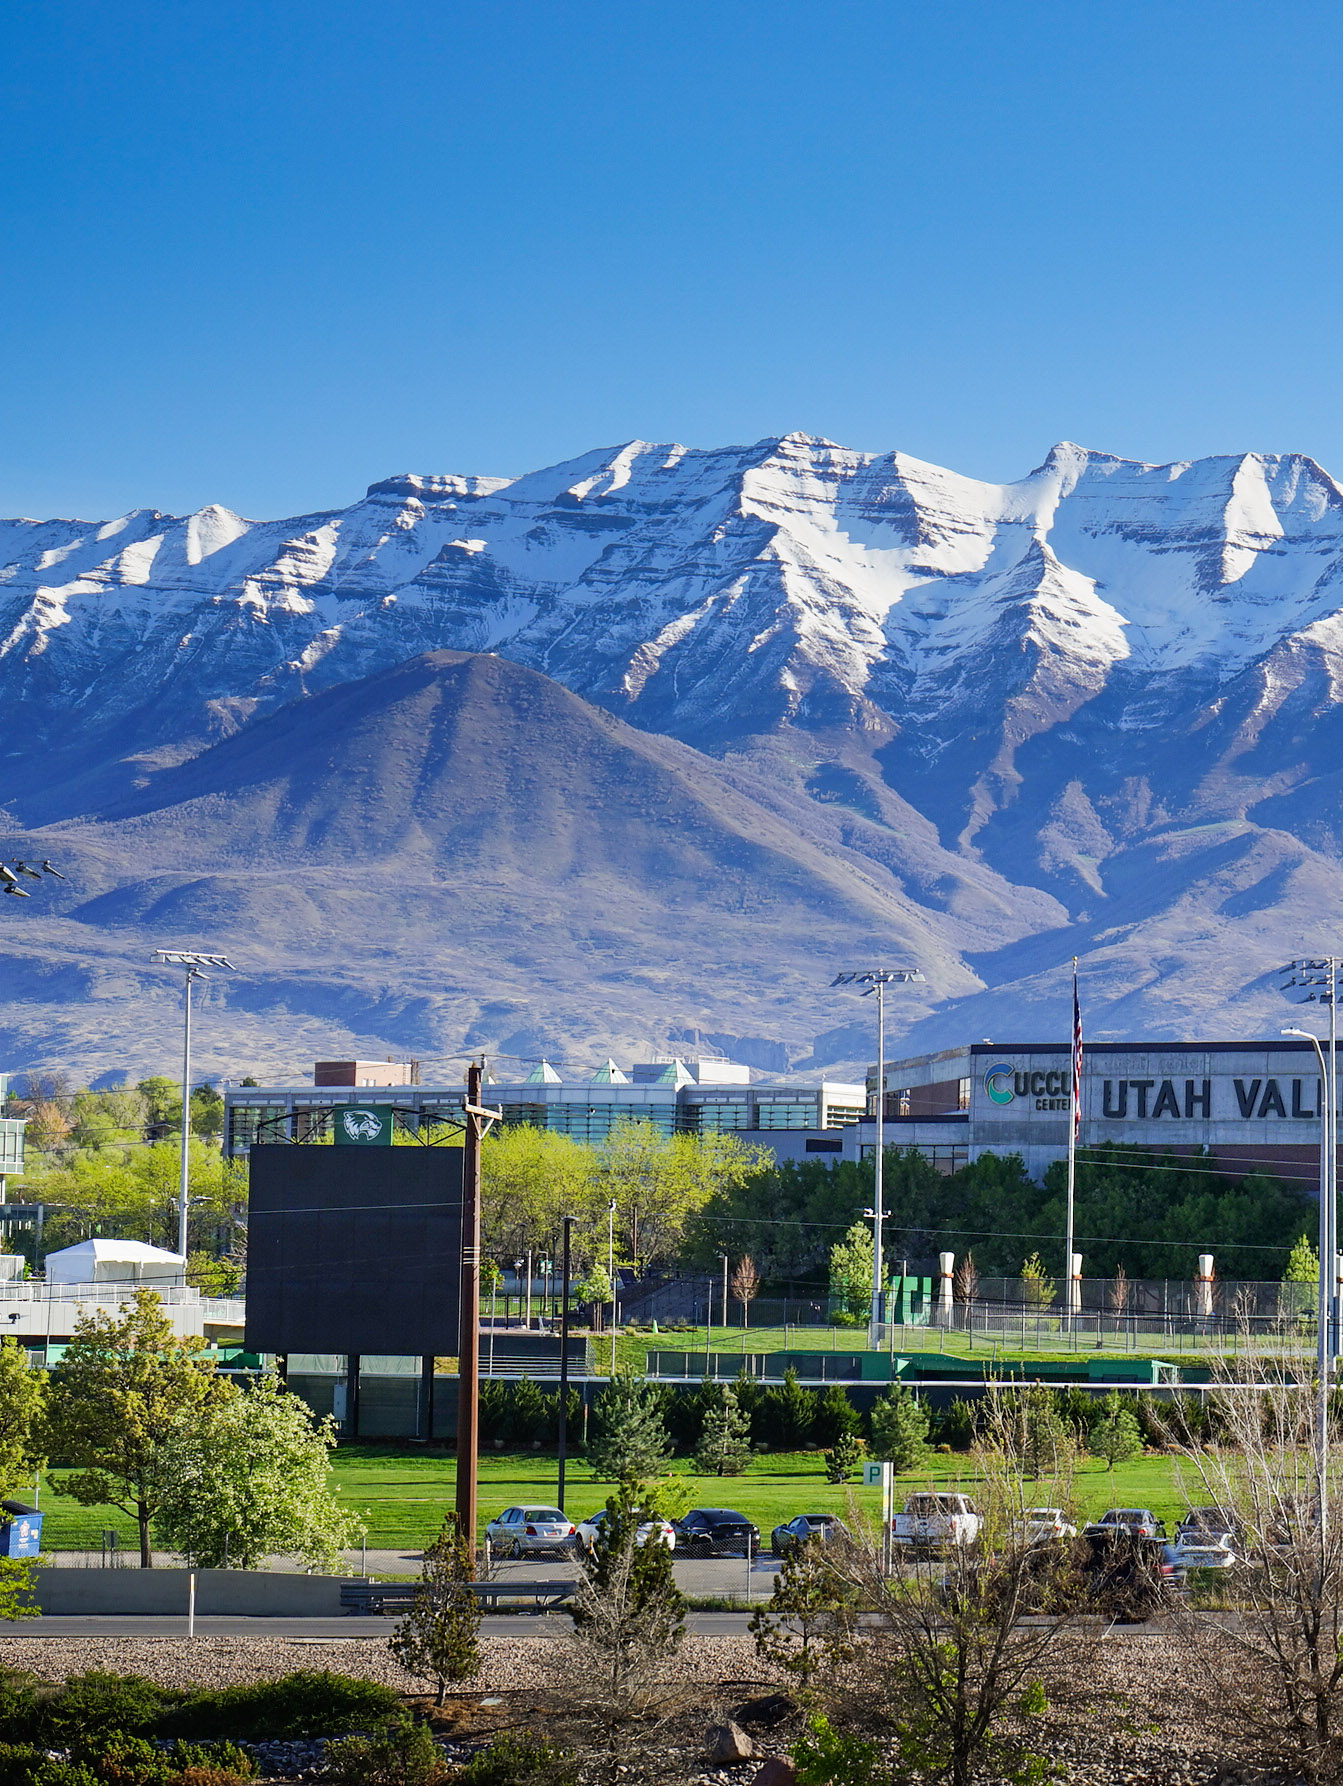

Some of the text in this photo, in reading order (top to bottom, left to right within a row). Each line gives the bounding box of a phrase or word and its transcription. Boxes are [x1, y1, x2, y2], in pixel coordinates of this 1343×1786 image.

[1014, 1071, 1071, 1097] UCCU
[1102, 1079, 1211, 1118] UTAH
[869, 1466, 881, 1483] P
